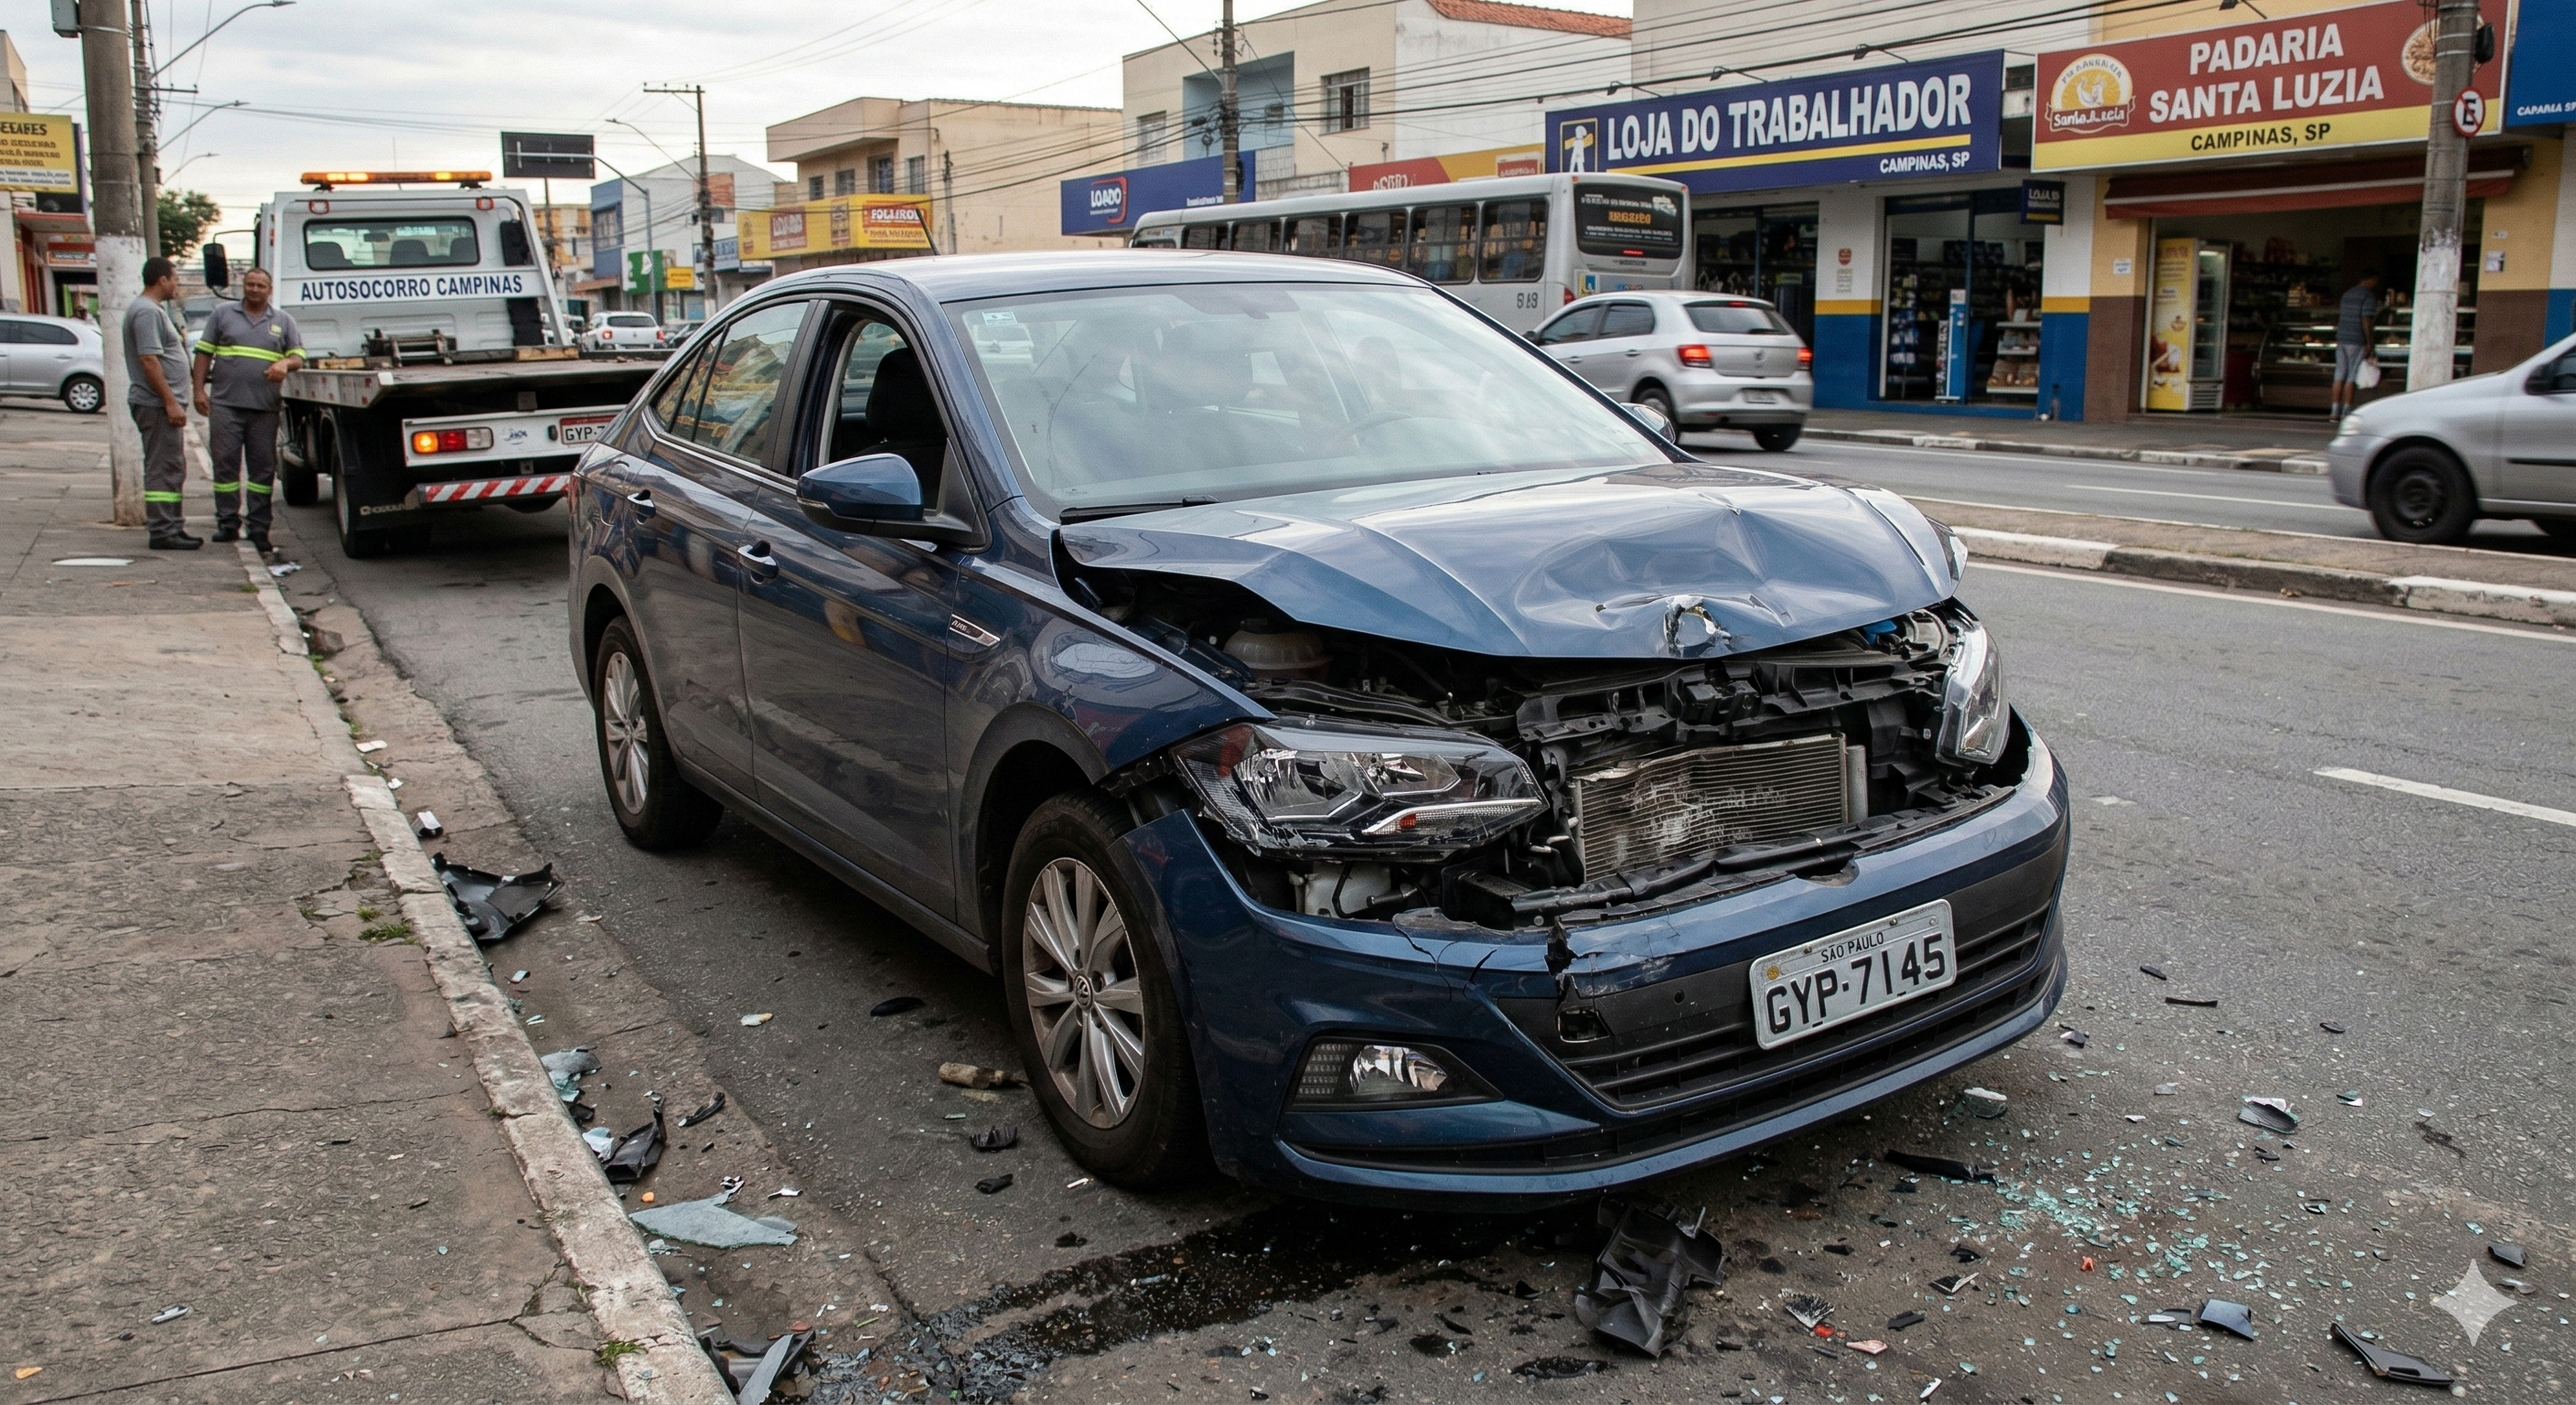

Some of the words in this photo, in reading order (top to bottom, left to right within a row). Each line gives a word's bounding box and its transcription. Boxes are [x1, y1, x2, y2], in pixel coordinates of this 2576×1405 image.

[2190, 23, 2344, 75] PADARIA
[2149, 80, 2262, 123] SANTA
[2272, 65, 2384, 110] LUZIA
[1607, 111, 1673, 161] LOJA
[1681, 104, 1720, 155] DO
[1728, 73, 1971, 148] TRABALHADOR
[2191, 126, 2298, 151] CAMPINAS,
[2304, 123, 2331, 141] SP
[1880, 154, 1949, 174] CAMPINAS,
[1951, 152, 1970, 168] SP
[301, 278, 430, 301] AUTOSOCORRO
[436, 274, 522, 295] CAMPINAS
[564, 425, 606, 441] GYP-7
[1820, 943, 1844, 963] SÃO
[1848, 931, 1884, 955] PAULO
[1766, 931, 1946, 1035] GYP-7145
